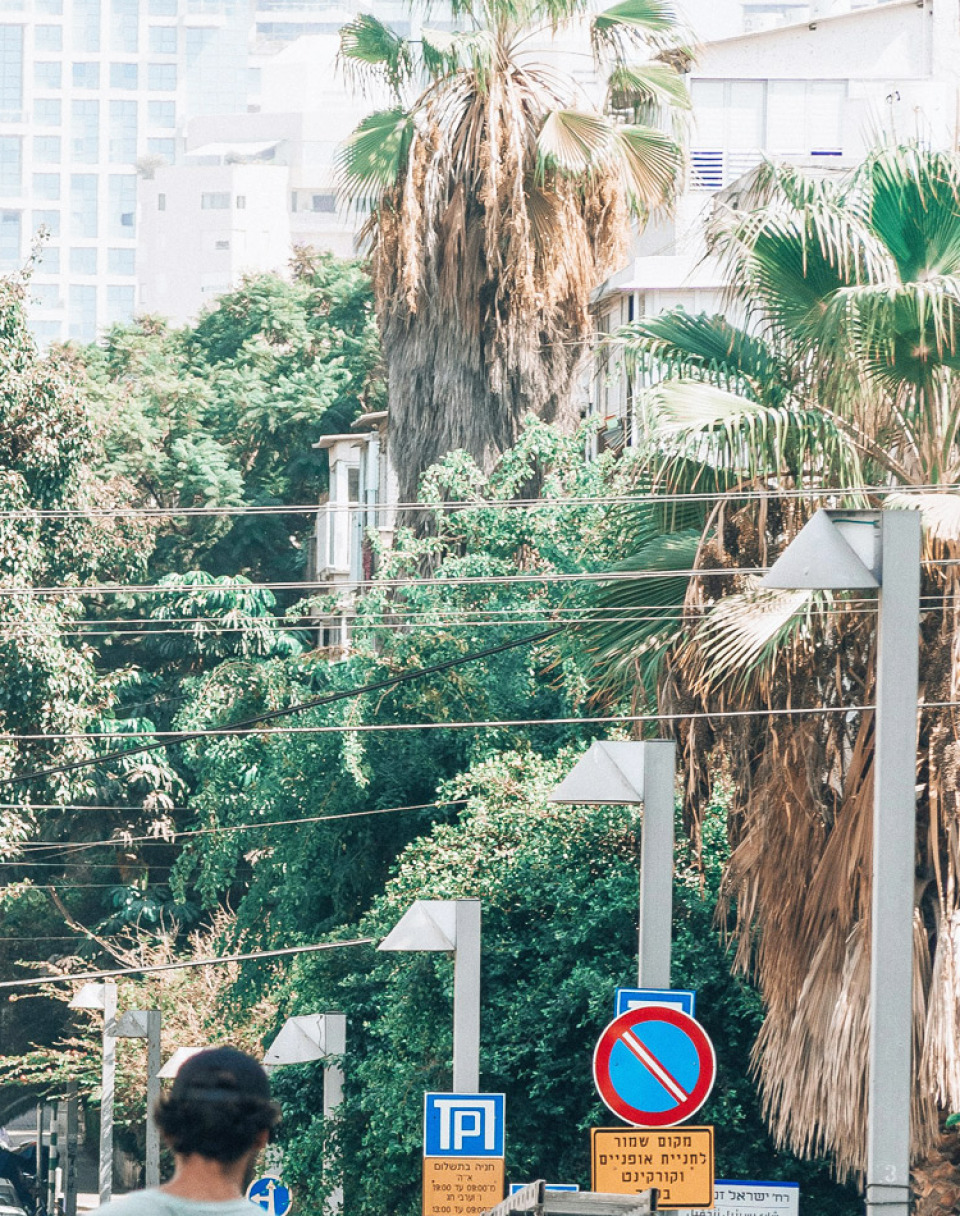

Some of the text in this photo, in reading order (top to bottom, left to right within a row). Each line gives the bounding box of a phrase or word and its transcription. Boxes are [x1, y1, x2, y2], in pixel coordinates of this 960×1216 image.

[614, 1136, 692, 1148] מקום שמור
[599, 1154, 653, 1165] אופניים
[434, 1162, 471, 1171] בתשלום
[622, 1172, 684, 1184] וקורקינט
[728, 1190, 770, 1201] ישראל
